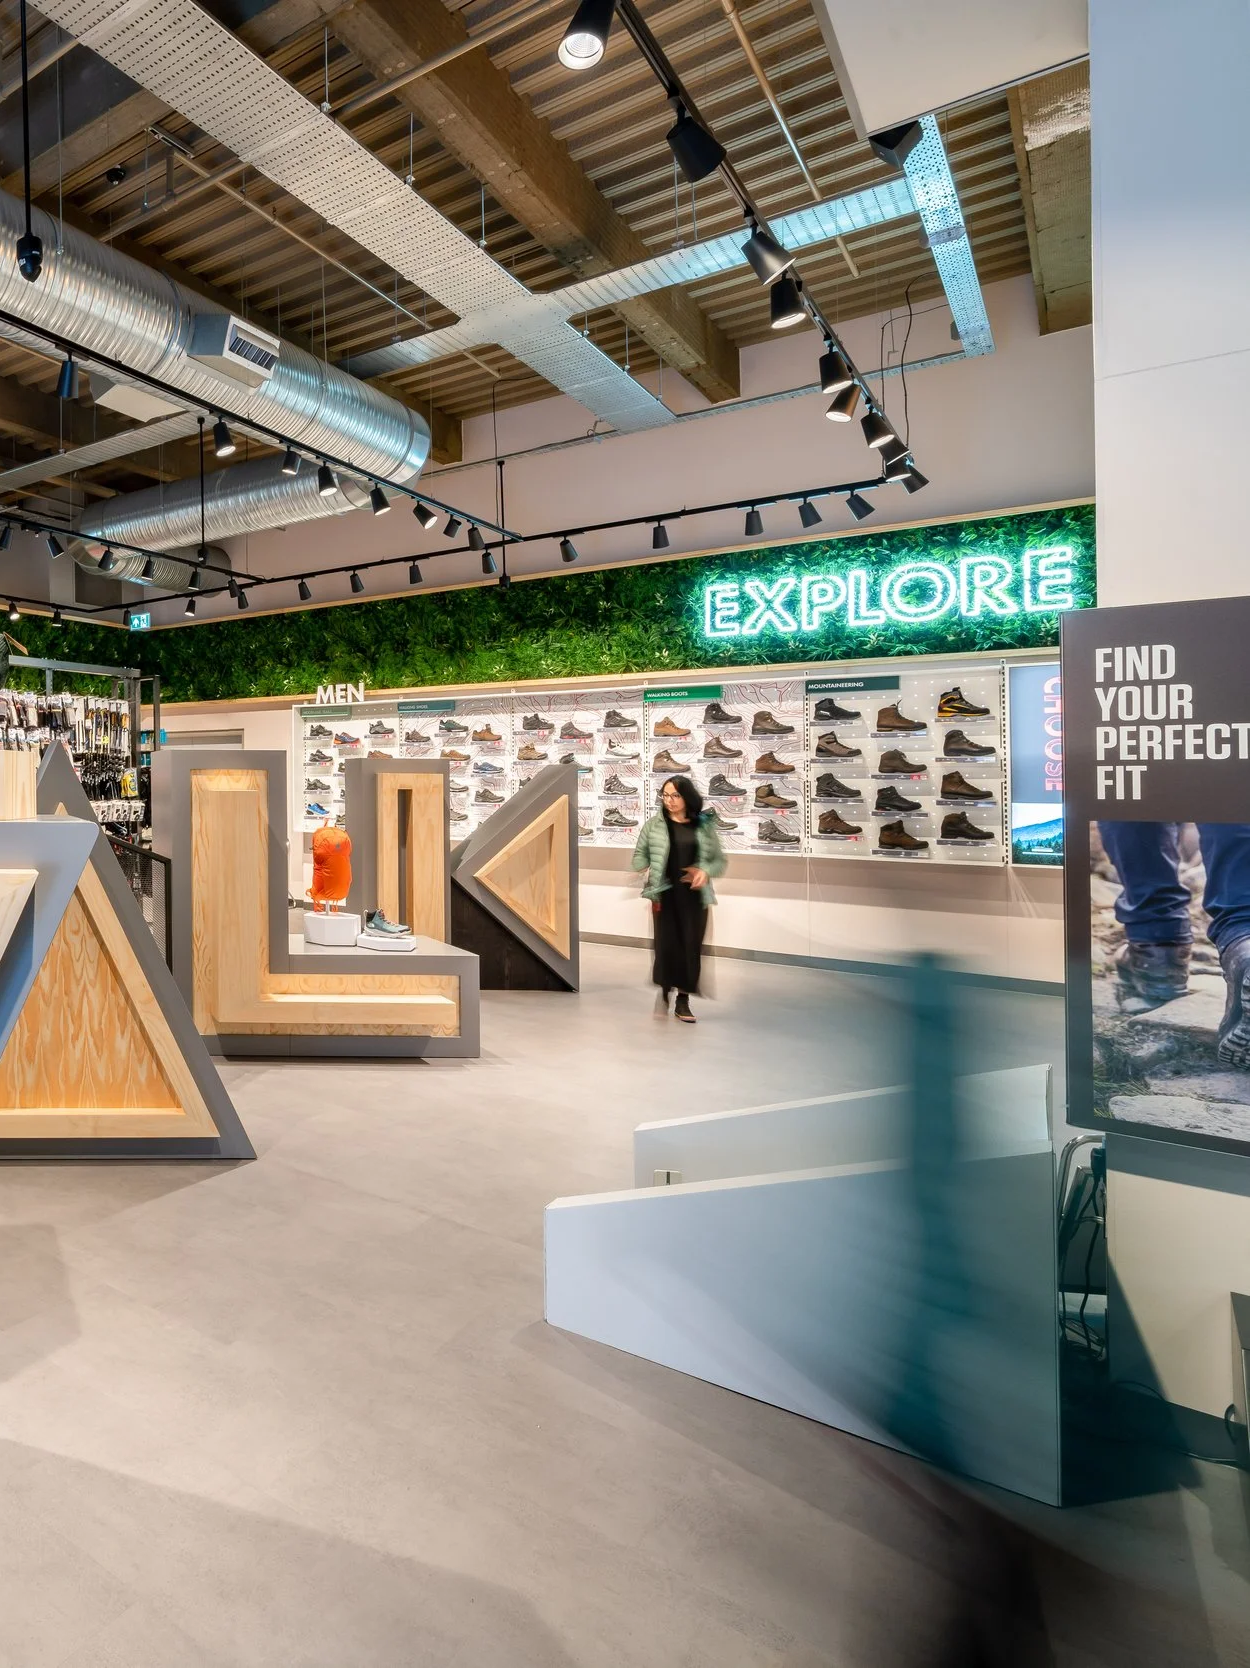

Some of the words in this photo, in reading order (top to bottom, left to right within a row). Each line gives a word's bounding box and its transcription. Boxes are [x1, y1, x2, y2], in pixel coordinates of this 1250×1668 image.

[704, 546, 1074, 639] EXPLORE
[1095, 644, 1176, 682] FIND
[315, 683, 365, 705] MEN
[807, 681, 864, 689] MOUNTAINEERING
[1094, 684, 1193, 721] YOUR
[1096, 723, 1250, 760] PERFECT
[1096, 765, 1147, 800] FIT
